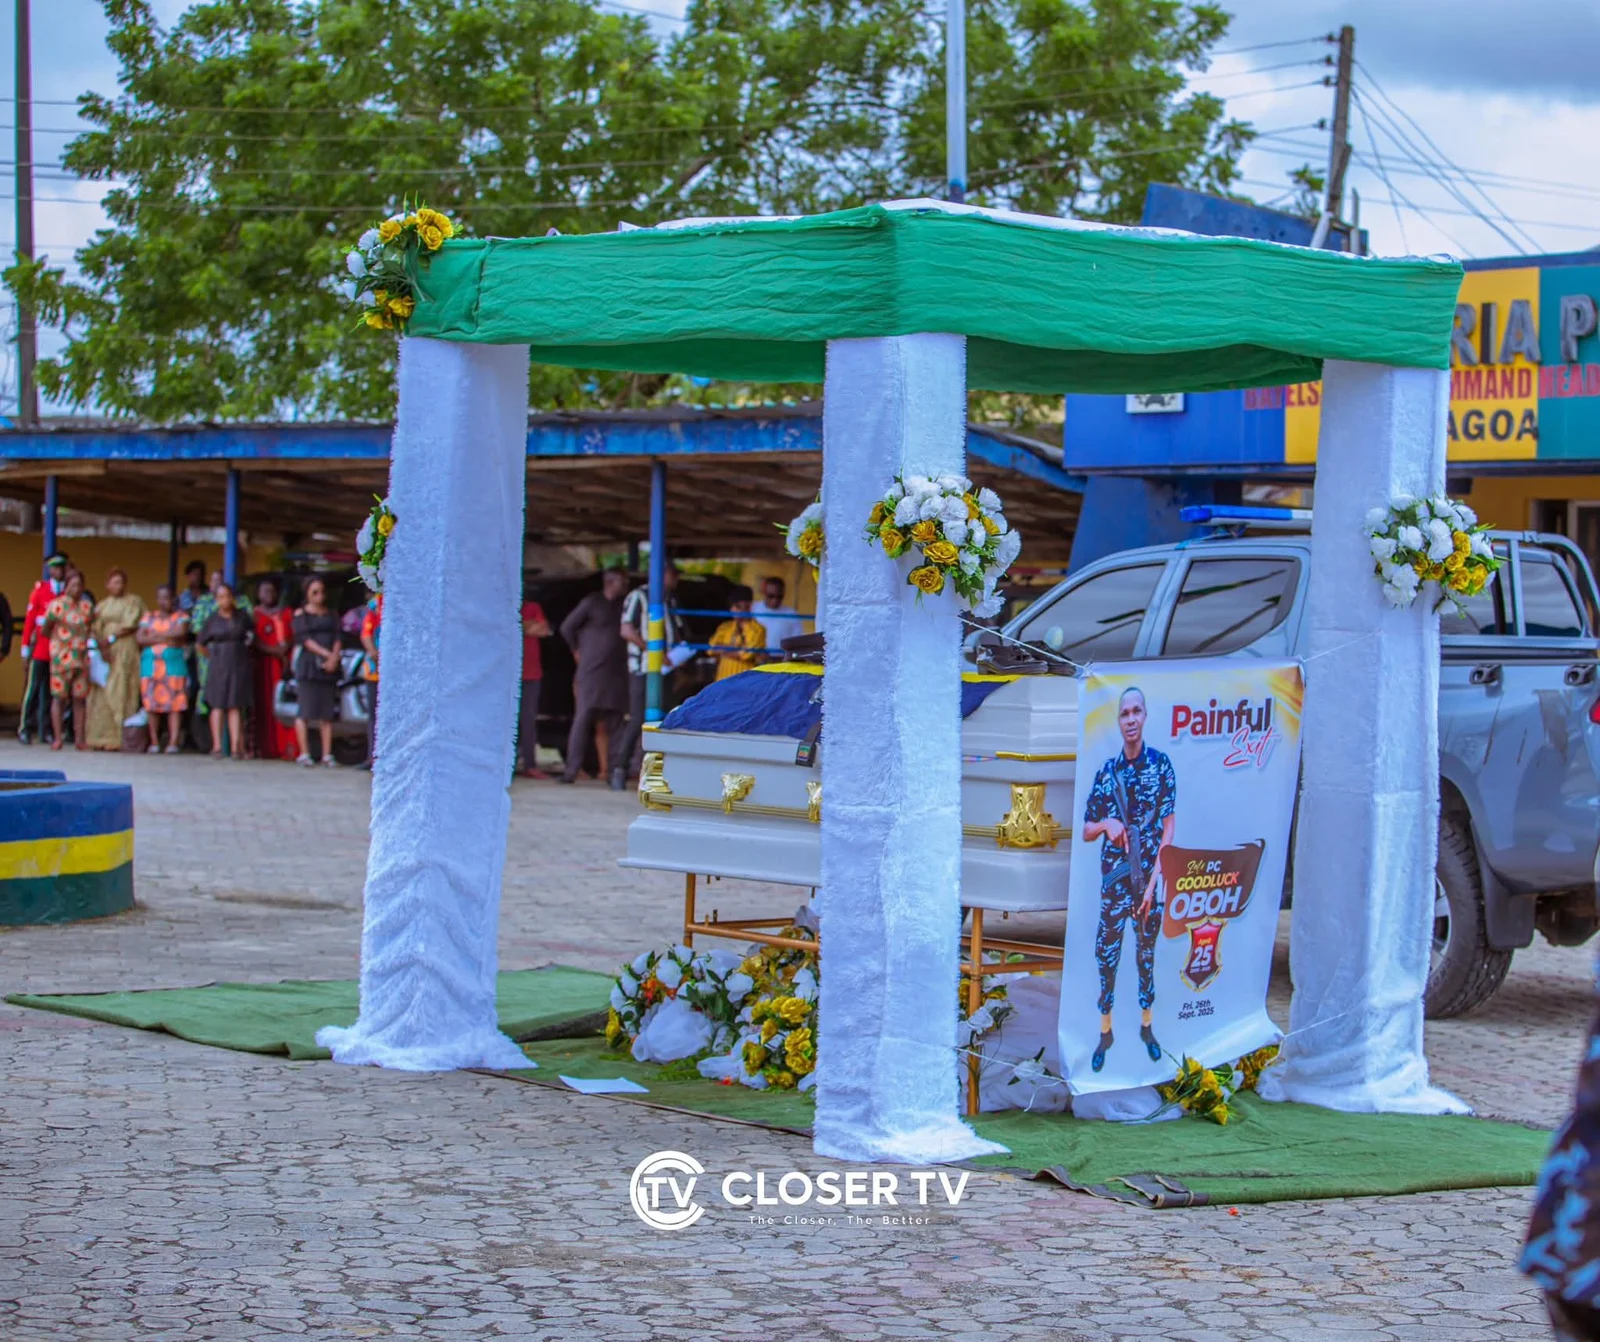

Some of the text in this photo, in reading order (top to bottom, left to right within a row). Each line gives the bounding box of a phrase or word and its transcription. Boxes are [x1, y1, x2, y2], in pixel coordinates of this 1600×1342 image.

[1171, 698, 1273, 737] Painful
[1224, 727, 1280, 767] Exit
[1206, 860, 1222, 872] PC
[1175, 871, 1240, 891] GOODLUCK
[1169, 886, 1243, 920] OBOH
[1190, 945, 1214, 968] 25
[1178, 1007, 1214, 1020] Sept. 2025
[1195, 1000, 1211, 1009] 26th
